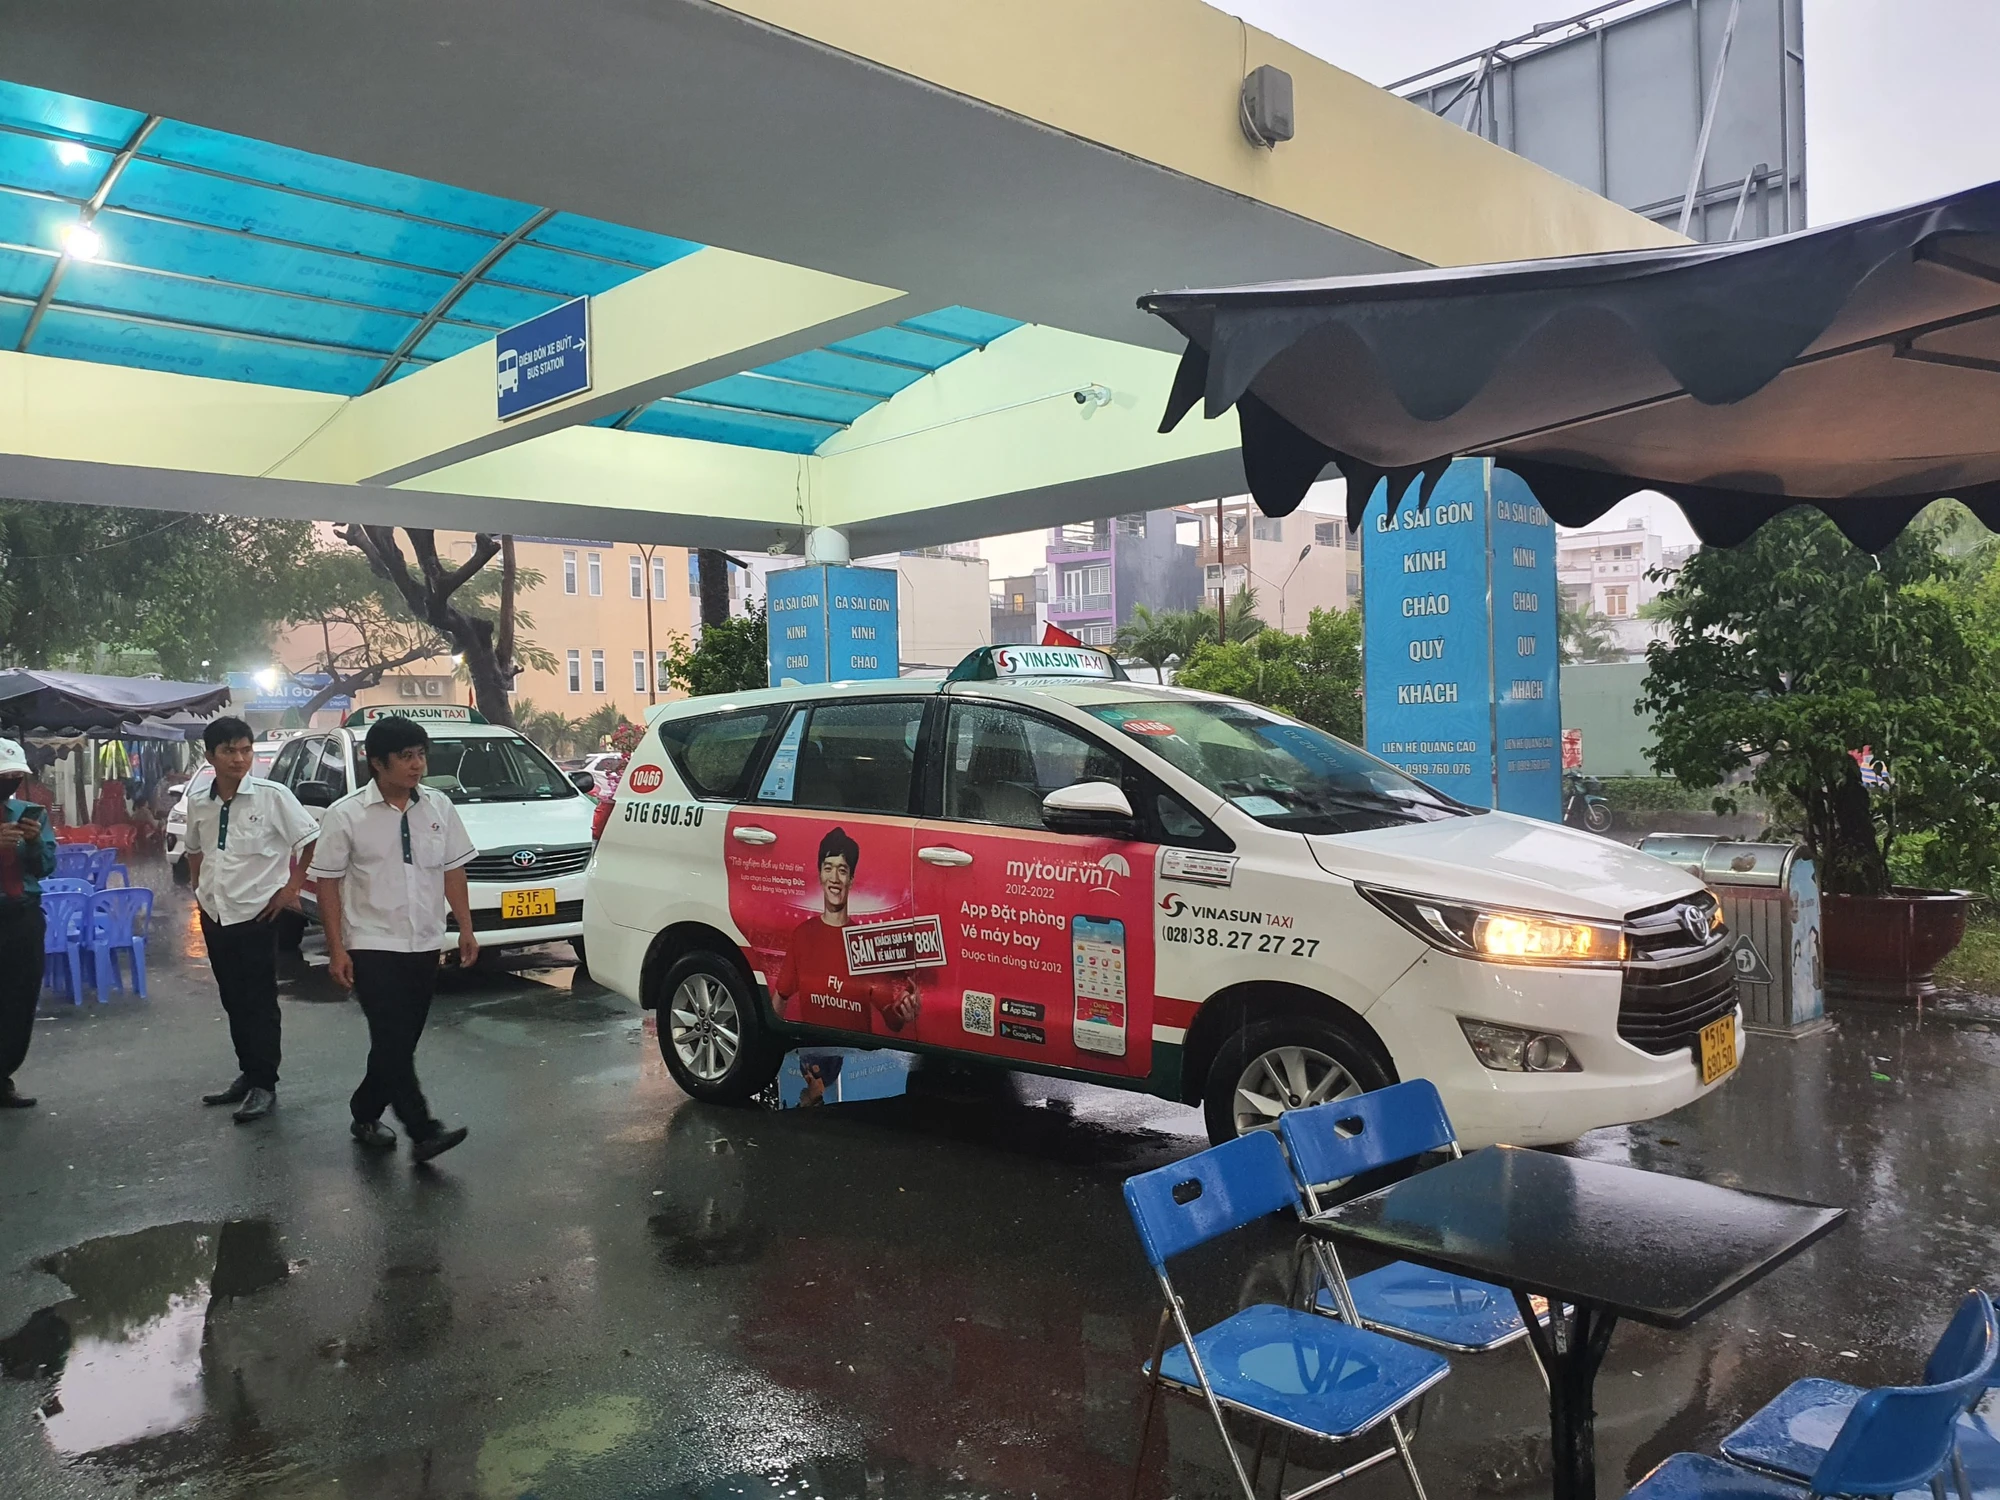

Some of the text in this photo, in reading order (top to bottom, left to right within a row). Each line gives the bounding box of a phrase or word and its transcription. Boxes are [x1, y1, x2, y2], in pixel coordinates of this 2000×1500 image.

[547, 343, 556, 356] XE
[527, 355, 564, 379] BUS STATION
[1435, 500, 1473, 525] GÒN
[1497, 500, 1511, 520] GA
[1403, 549, 1446, 573] KÍNH
[773, 598, 785, 612] GA
[835, 595, 849, 609] GA
[1402, 592, 1450, 617] CHÀO
[1409, 635, 1445, 662] QUÝ
[1398, 681, 1458, 705] KHÁCH
[633, 770, 661, 786] 10466
[1405, 763, 1471, 775] 0919.760.076
[624, 802, 704, 827] 51G 690.50
[1006, 860, 1102, 885] mytour.vn
[517, 892, 540, 904] 51F
[1005, 883, 1055, 899] 2012-2022
[508, 903, 549, 917] 761.31
[960, 900, 1066, 931] App Đặt phòng
[1191, 905, 1294, 929] VINASUN TAXI
[914, 930, 939, 954] 88K
[961, 923, 1041, 951] Vé máy bay
[851, 935, 876, 964] SĂN
[961, 948, 986, 963] Được
[987, 952, 1000, 963] tin
[1041, 961, 1062, 974] 2012
[828, 975, 844, 994] Fly
[810, 993, 862, 1013] mytour.vn
[1009, 1006, 1037, 1018] App Store
[1012, 1029, 1032, 1040] Google
[1709, 1022, 1726, 1050] 51G
